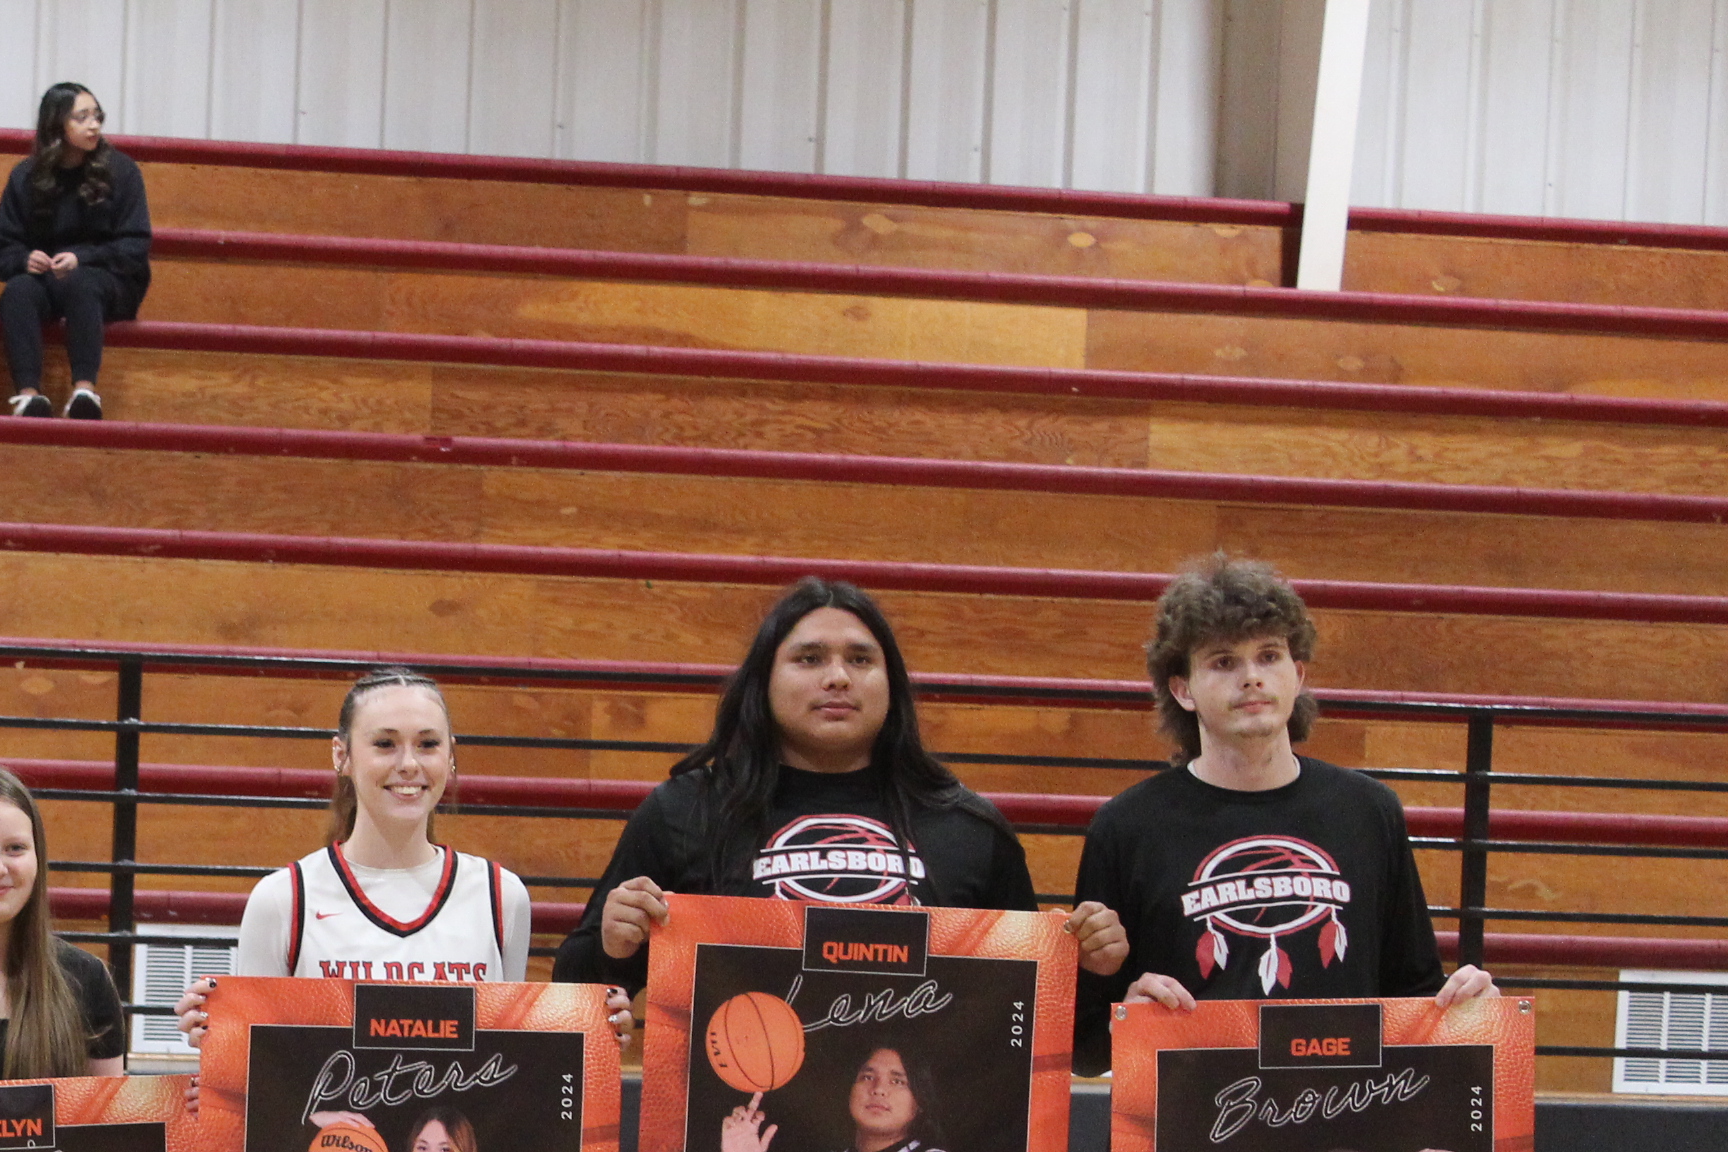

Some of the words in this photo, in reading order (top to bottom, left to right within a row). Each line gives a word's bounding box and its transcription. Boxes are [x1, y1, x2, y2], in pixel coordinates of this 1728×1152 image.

[1181, 876, 1350, 917] EARLSBORO
[822, 941, 909, 964] QUINTIN
[369, 1018, 459, 1039] NATALIE
[1011, 1000, 1024, 1048] 2024
[1290, 1037, 1352, 1057] GAGE
[302, 1049, 518, 1126] Peters
[561, 1072, 573, 1120] 2024
[1208, 1067, 1432, 1143] Brown
[1471, 1085, 1483, 1132] 2024
